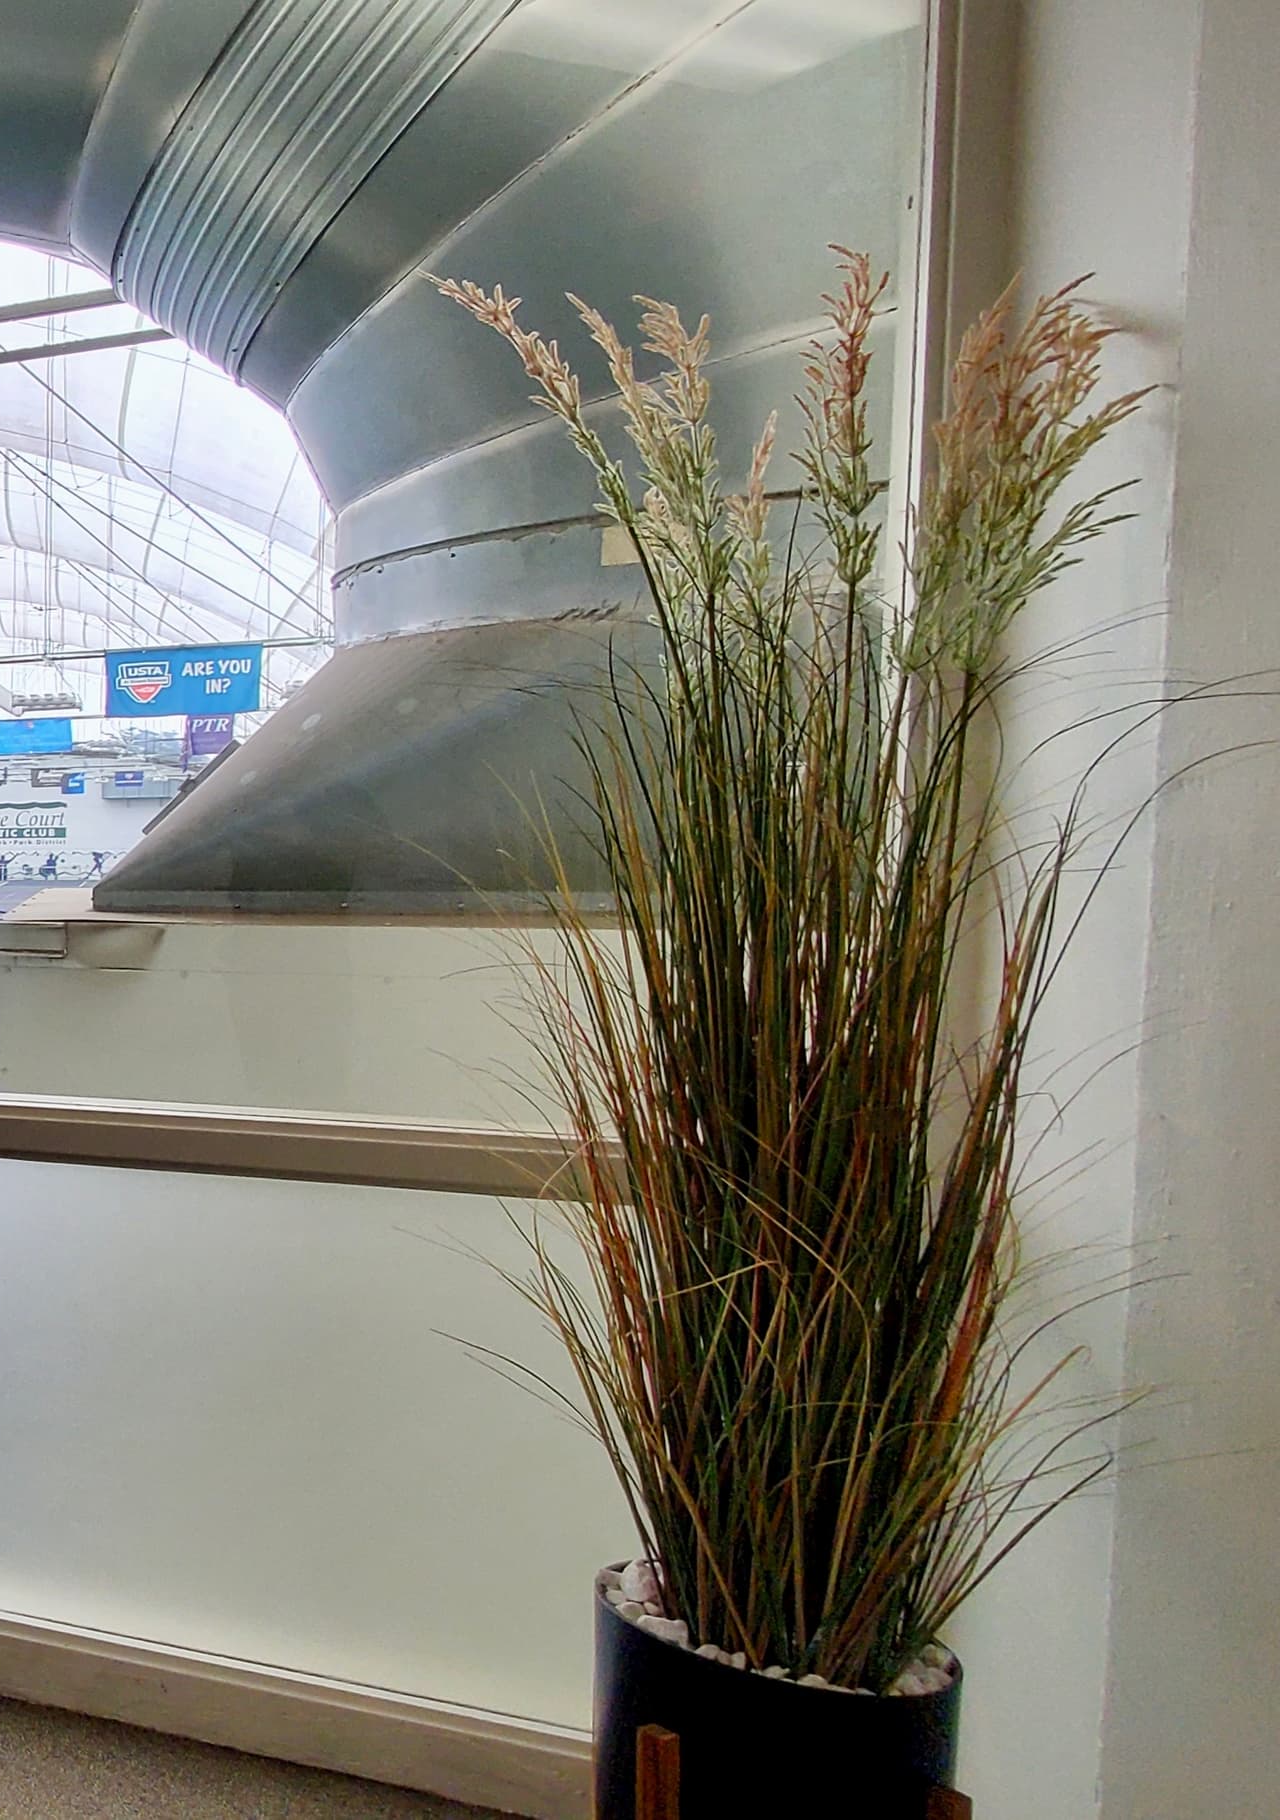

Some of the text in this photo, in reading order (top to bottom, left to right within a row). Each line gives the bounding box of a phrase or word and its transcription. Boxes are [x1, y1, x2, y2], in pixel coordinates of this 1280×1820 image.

[128, 666, 163, 676] USTA
[181, 659, 252, 676] ARE YOU
[205, 678, 231, 694] IN?
[192, 718, 229, 733] PTR
[15, 811, 65, 827] Court
[23, 828, 56, 837] CLUB
